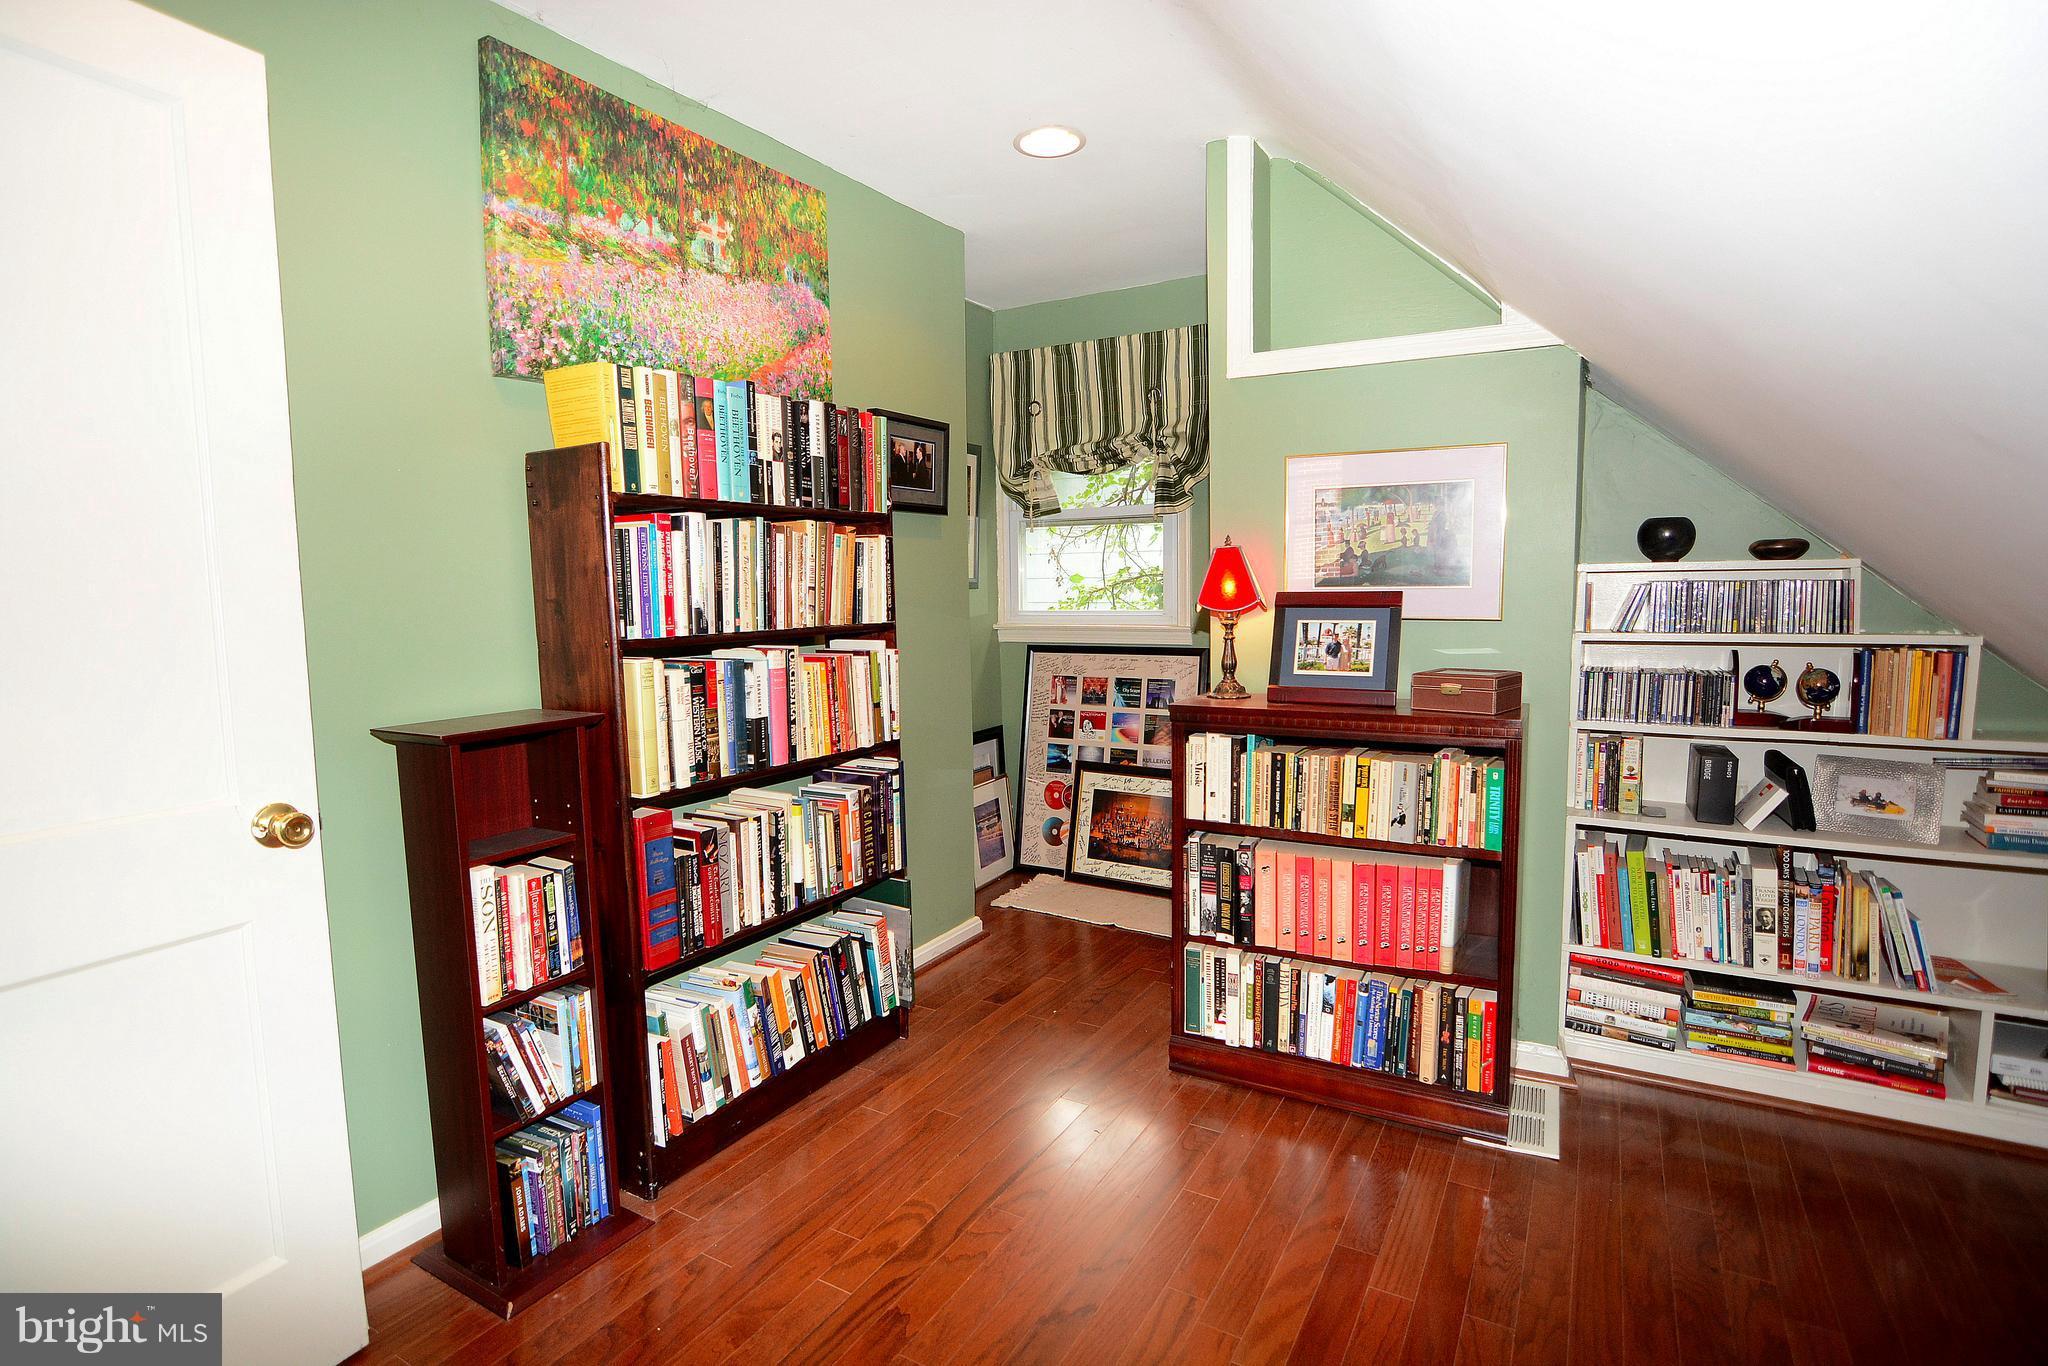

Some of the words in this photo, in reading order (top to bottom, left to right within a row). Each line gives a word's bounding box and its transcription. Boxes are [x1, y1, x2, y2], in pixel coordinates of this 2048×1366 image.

[659, 396, 668, 452] BEETHOVEN
[718, 404, 727, 464] BEETHOVEN
[686, 429, 698, 480] Beethoven
[731, 409, 741, 477] BEETHOVEN
[667, 560, 672, 570] OF
[692, 697, 700, 735] WESTERN
[694, 736, 703, 764] MUSIC
[1194, 762, 1204, 787] Music
[1703, 759, 1712, 780] BRIDGE
[1489, 786, 1501, 821] TRINITY
[1329, 814, 1339, 831] ATLAS
[864, 811, 874, 868] CARNEGIE
[718, 831, 730, 896] MOZART
[480, 886, 495, 934] SON
[532, 898, 540, 918] Daniel
[548, 916, 557, 930] Silva
[1796, 914, 1806, 956] LONDON
[1809, 917, 1820, 951] PARIS
[1596, 958, 1619, 966] GOOD
[1696, 992, 1730, 1002] NORTHERN
[1374, 1002, 1382, 1021] Norton
[768, 1015, 779, 1043] ORDINARY
[1455, 1015, 1464, 1039] AMERICAN
[772, 1045, 782, 1062] TIME
[1455, 1039, 1463, 1051] RUST
[1817, 1065, 1844, 1075] CHANGE
[1848, 1054, 1868, 1062] MOMENT
[496, 1066, 516, 1099] SEABISCUIT
[516, 1186, 524, 1205] JOHN
[517, 1206, 526, 1232] ADAMS
